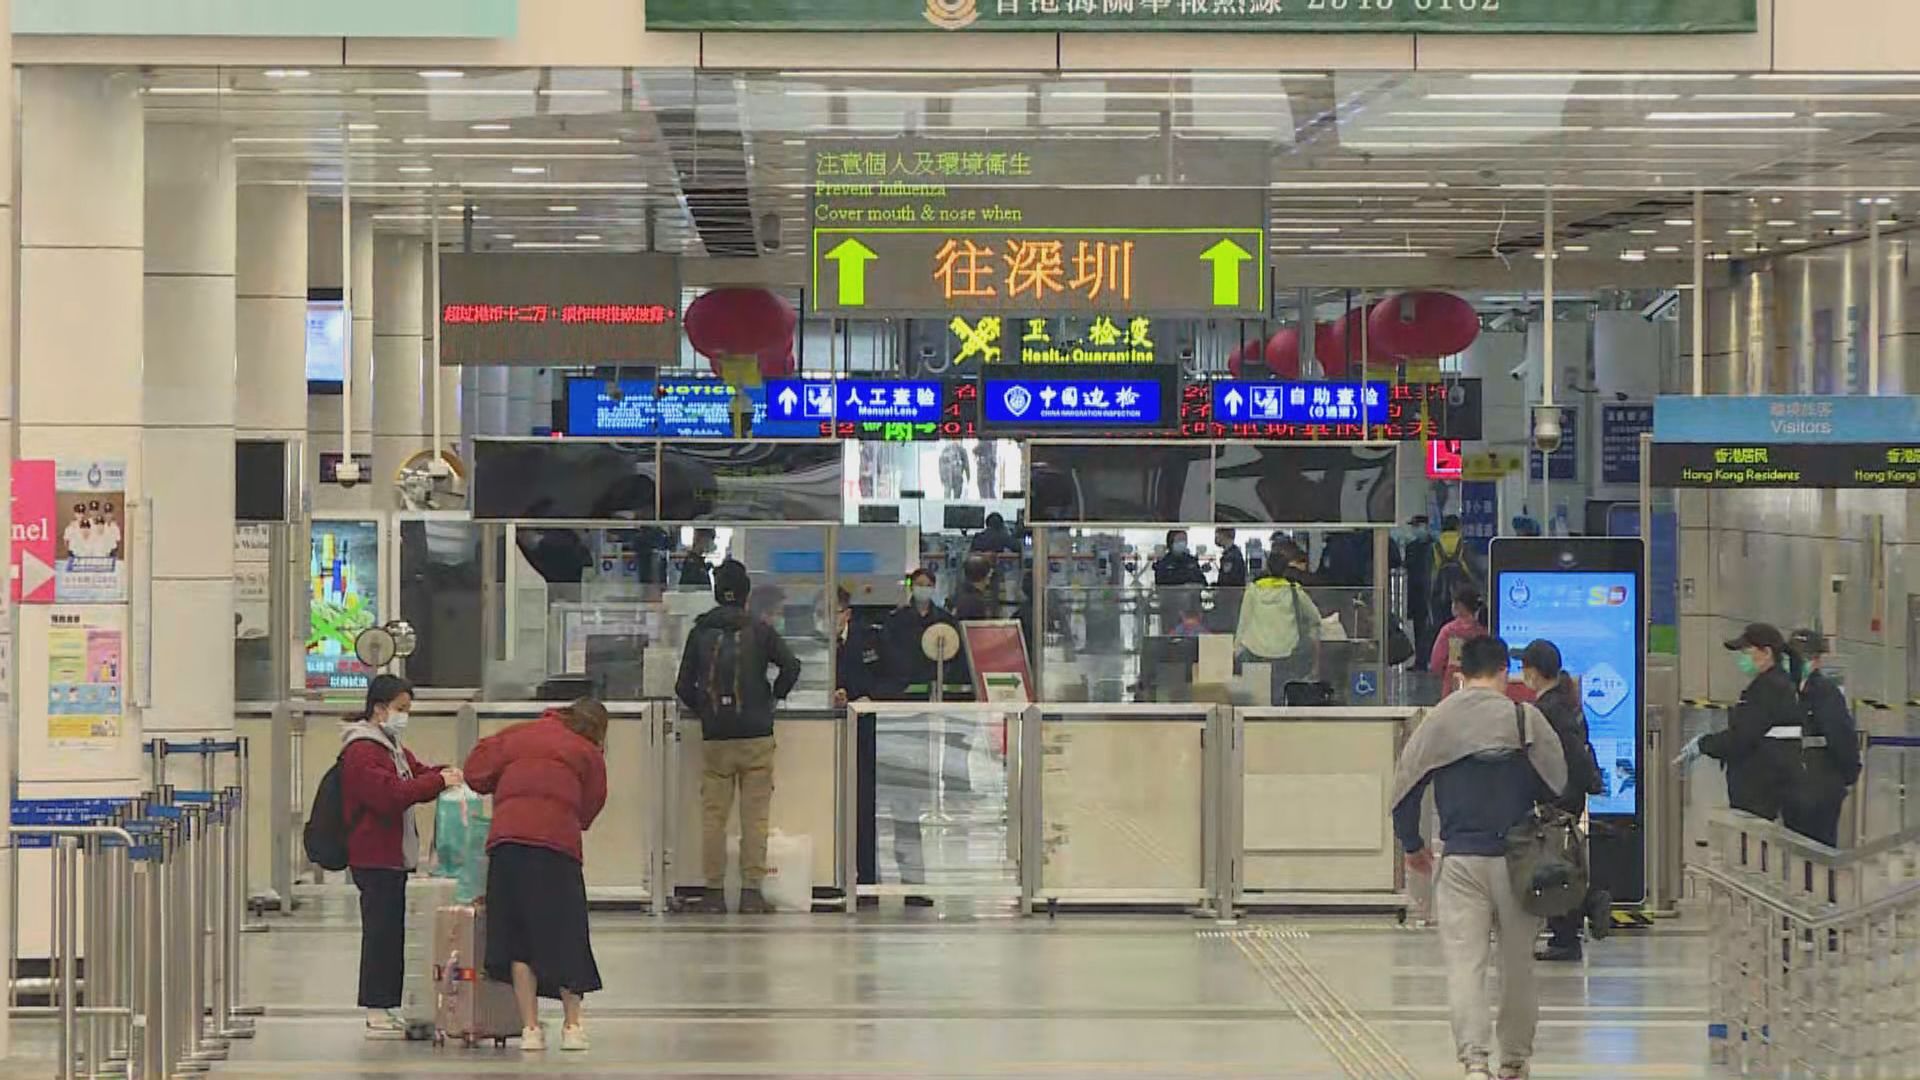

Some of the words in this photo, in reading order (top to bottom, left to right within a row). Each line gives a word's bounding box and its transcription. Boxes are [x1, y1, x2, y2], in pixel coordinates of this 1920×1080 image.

[816, 152, 1032, 175] 注意個人及環境衛生
[815, 180, 873, 196] Prevent
[879, 180, 946, 196] Influenza
[815, 203, 863, 221] Cover
[867, 203, 915, 221] mouth
[921, 204, 935, 221] &
[940, 207, 976, 221] nose
[981, 203, 1022, 221] when
[933, 238, 1135, 300] 往深圳
[1022, 316, 1154, 348] 卫检疫
[1073, 347, 1154, 364] Quarantine
[845, 386, 935, 407] 人工查验
[1039, 385, 1141, 409] 中国边检
[1290, 386, 1379, 406] 自助查验
[858, 405, 893, 417] Manual
[894, 405, 918, 417] Lane
[1770, 420, 1833, 434] Visitors
[1714, 448, 1768, 463] 香港居民
[1683, 468, 1712, 483] Hong
[1715, 468, 1744, 483] Kong
[1748, 468, 1801, 482] Residents
[1855, 468, 1885, 483] Hong
[1888, 468, 1916, 483] Kong
[11, 518, 49, 541] nel
